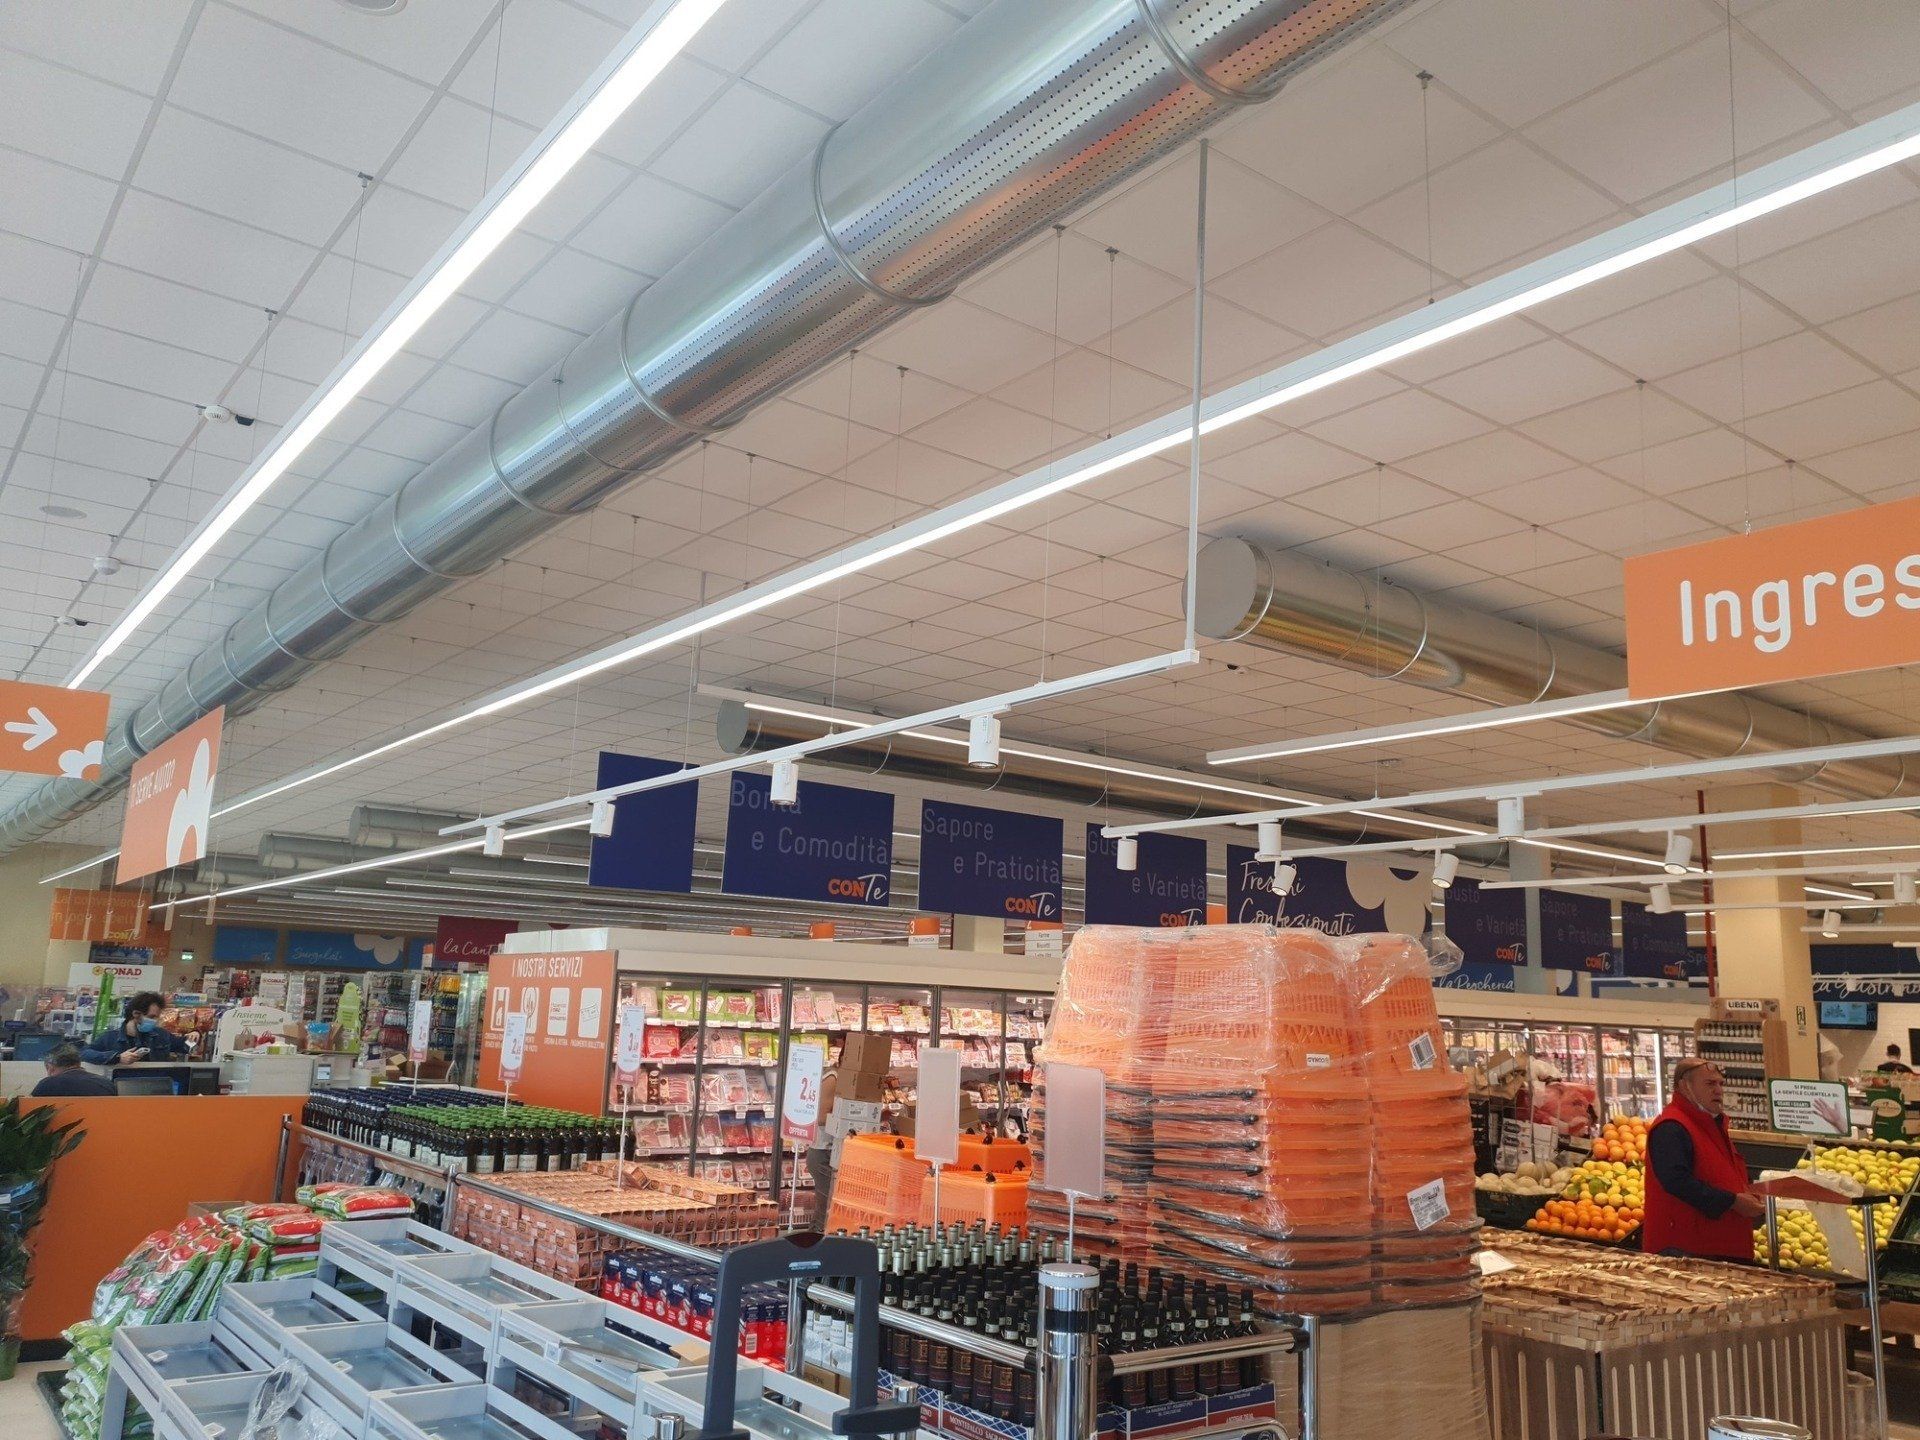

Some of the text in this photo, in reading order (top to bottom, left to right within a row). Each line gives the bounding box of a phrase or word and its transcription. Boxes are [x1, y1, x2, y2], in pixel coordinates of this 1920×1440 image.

[923, 808, 994, 845] Sapore
[751, 826, 888, 865] e Comodità
[1088, 830, 1118, 856] Gus
[953, 850, 1062, 885] e Praticità
[1131, 872, 1206, 901] e Varietà
[910, 920, 915, 934] 3
[443, 937, 459, 954] la
[517, 957, 546, 977] NOSTRI
[548, 956, 584, 978] SERVIZI
[232, 1009, 267, 1020] Insieme
